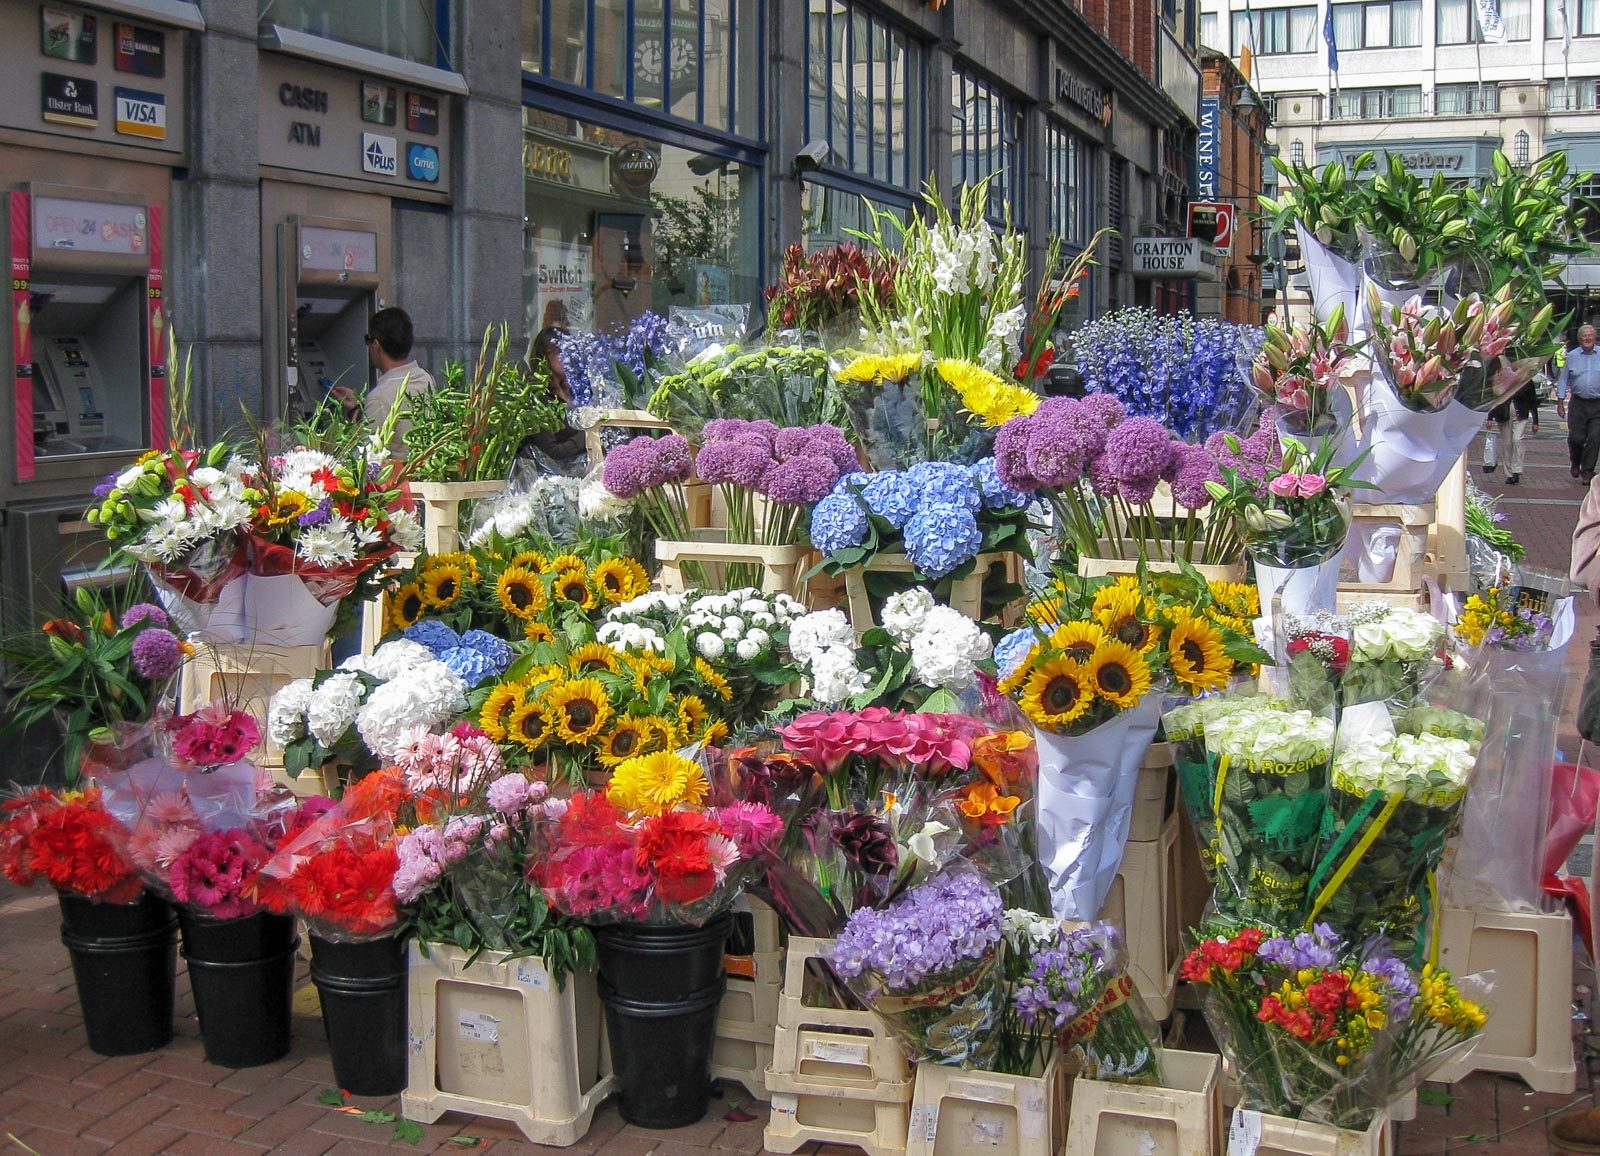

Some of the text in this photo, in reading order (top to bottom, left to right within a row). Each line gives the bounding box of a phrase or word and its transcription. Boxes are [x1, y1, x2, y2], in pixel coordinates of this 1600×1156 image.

[135, 41, 161, 54] BANKLINK
[48, 97, 94, 115] Ulster Bank
[279, 83, 328, 113] CASH
[125, 101, 157, 124] VISA
[288, 121, 321, 147] ATM
[1200, 111, 1213, 165] WINE
[374, 157, 395, 171] PLUS
[414, 157, 435, 170] Cirrus
[1346, 152, 1463, 170] Te estbury
[102, 220, 138, 238] ASH
[1134, 242, 1193, 256] GRAFTON
[1143, 256, 1185, 270] HOUSE
[538, 263, 582, 284] Switch
[1261, 757, 1315, 776] Rozen
